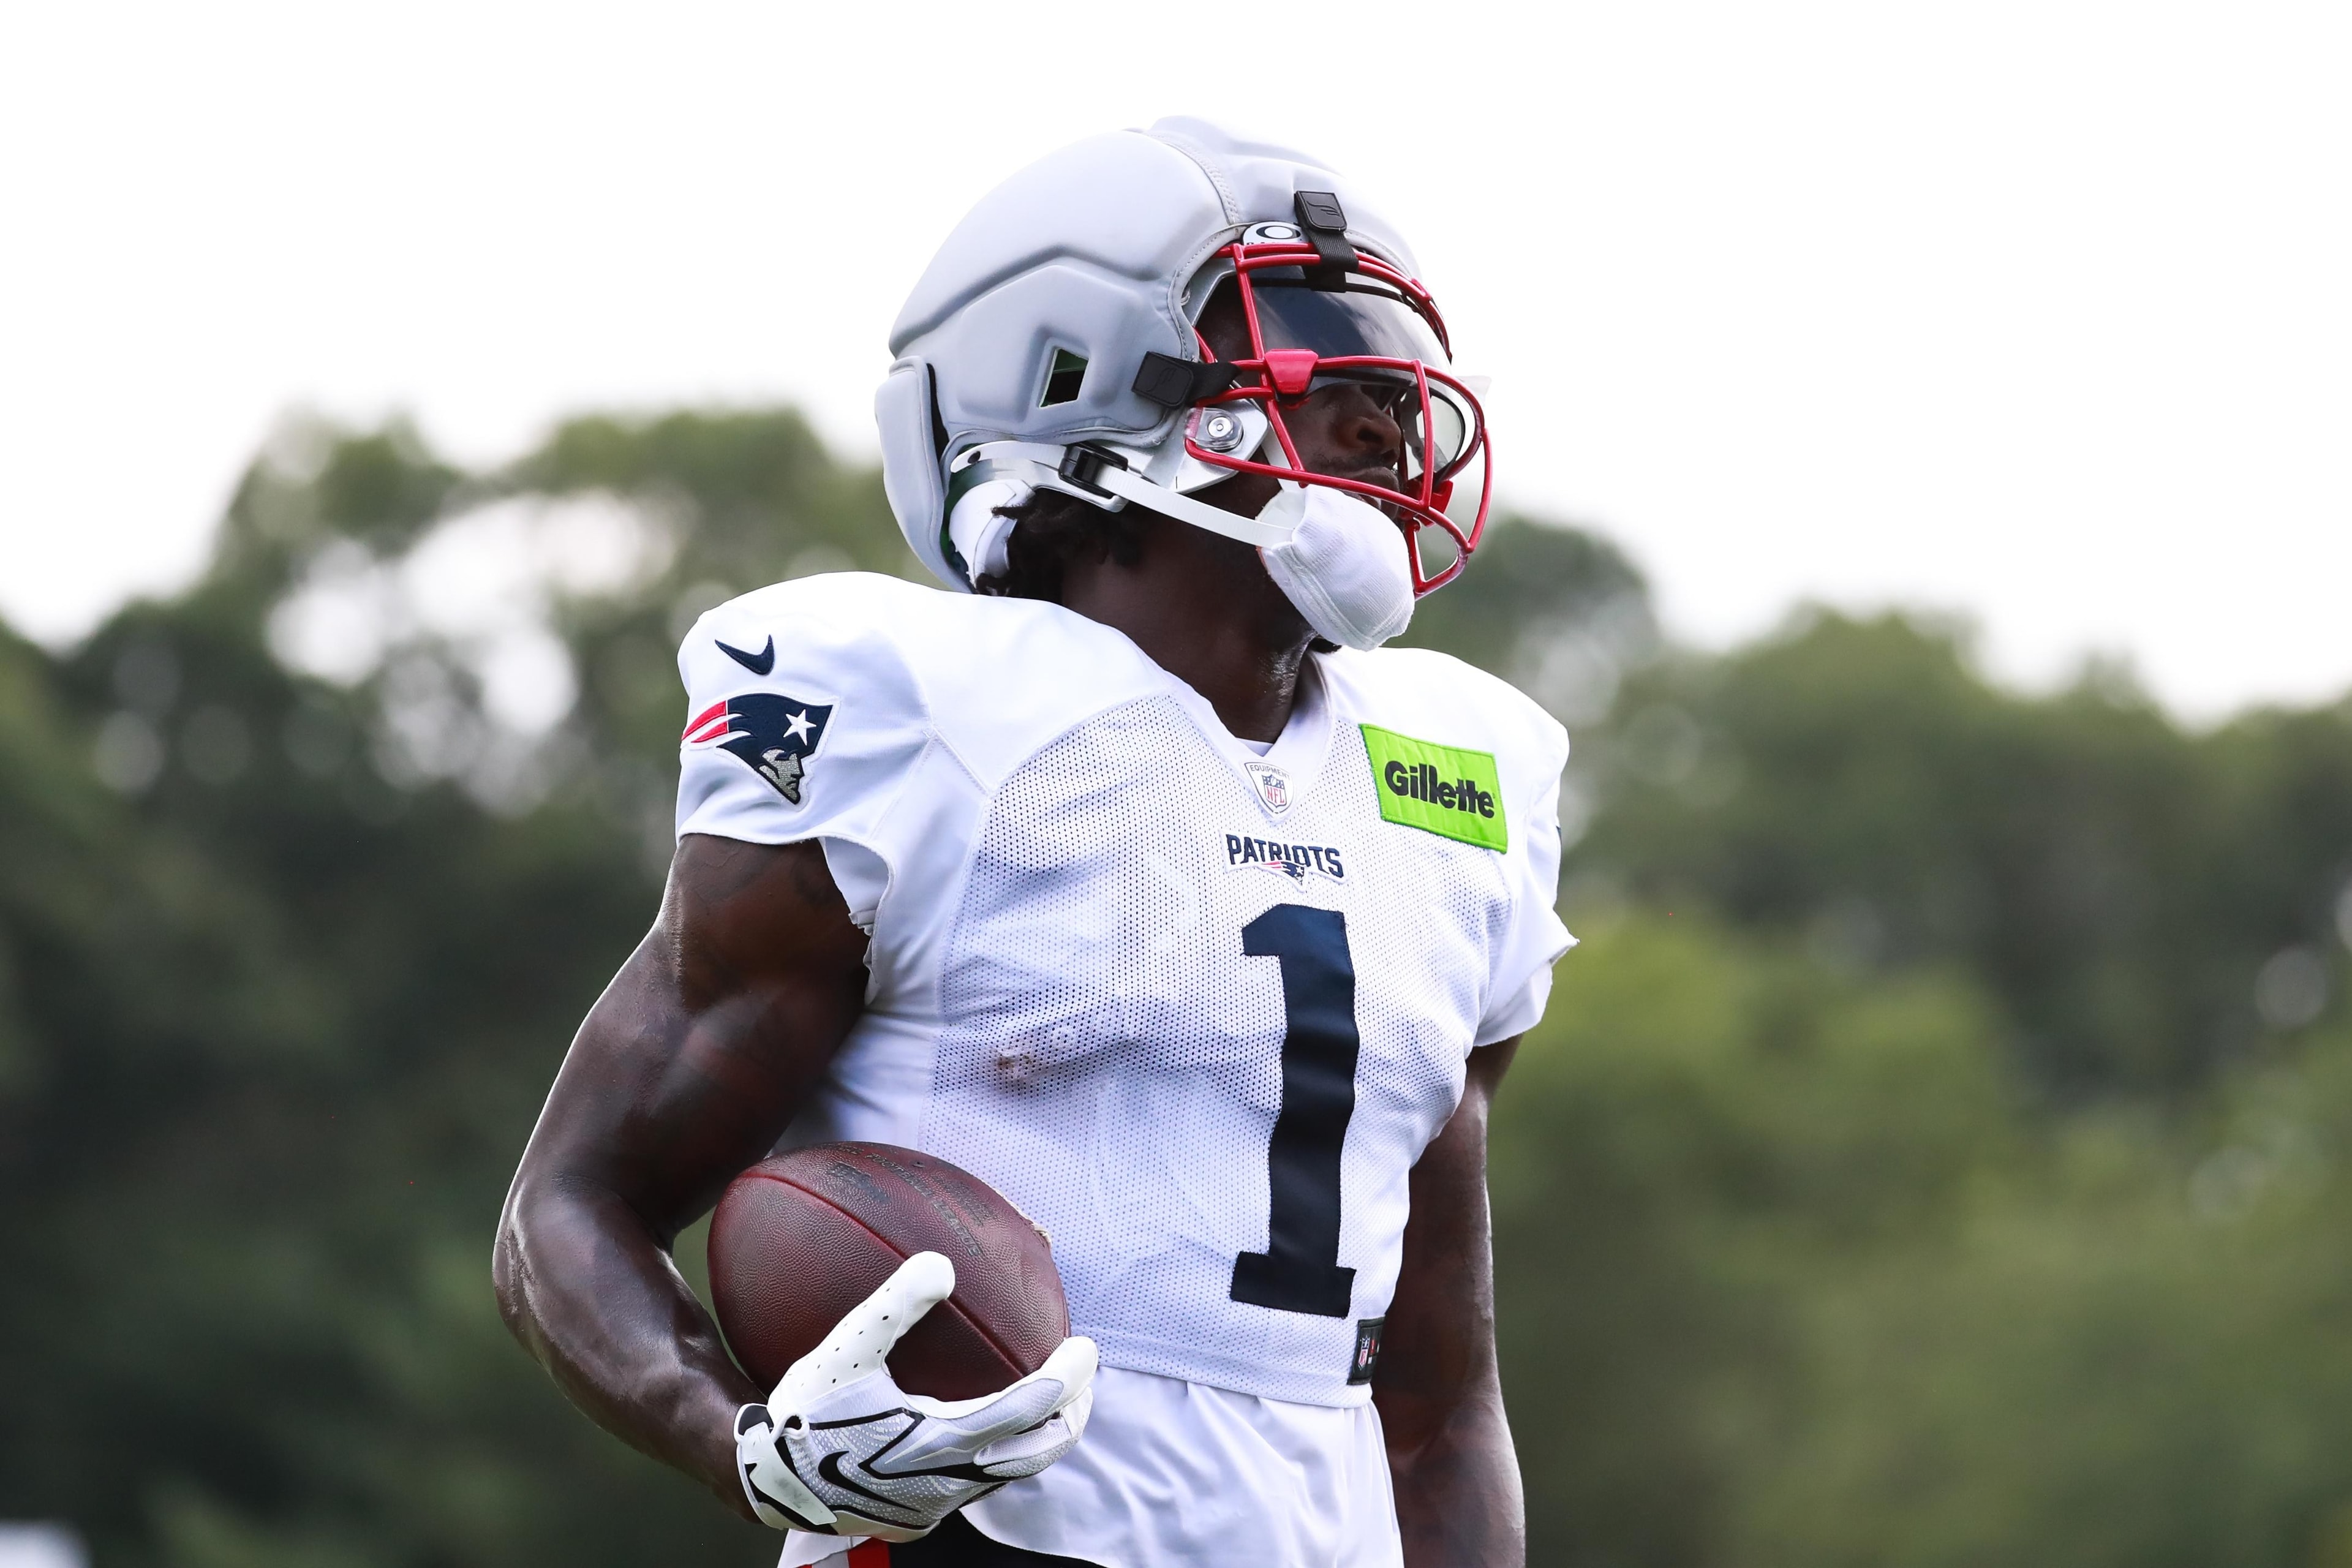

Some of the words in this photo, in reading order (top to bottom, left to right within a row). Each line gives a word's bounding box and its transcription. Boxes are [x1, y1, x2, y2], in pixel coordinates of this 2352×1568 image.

[1249, 764, 1291, 781] EQUIPMENT
[1266, 786, 1285, 804] NFL
[1384, 761, 1495, 818] Gillette
[1225, 834, 1344, 878] PATRIOTS
[1229, 903, 1360, 1319] 1
[932, 1200, 982, 1257] LEAGUE
